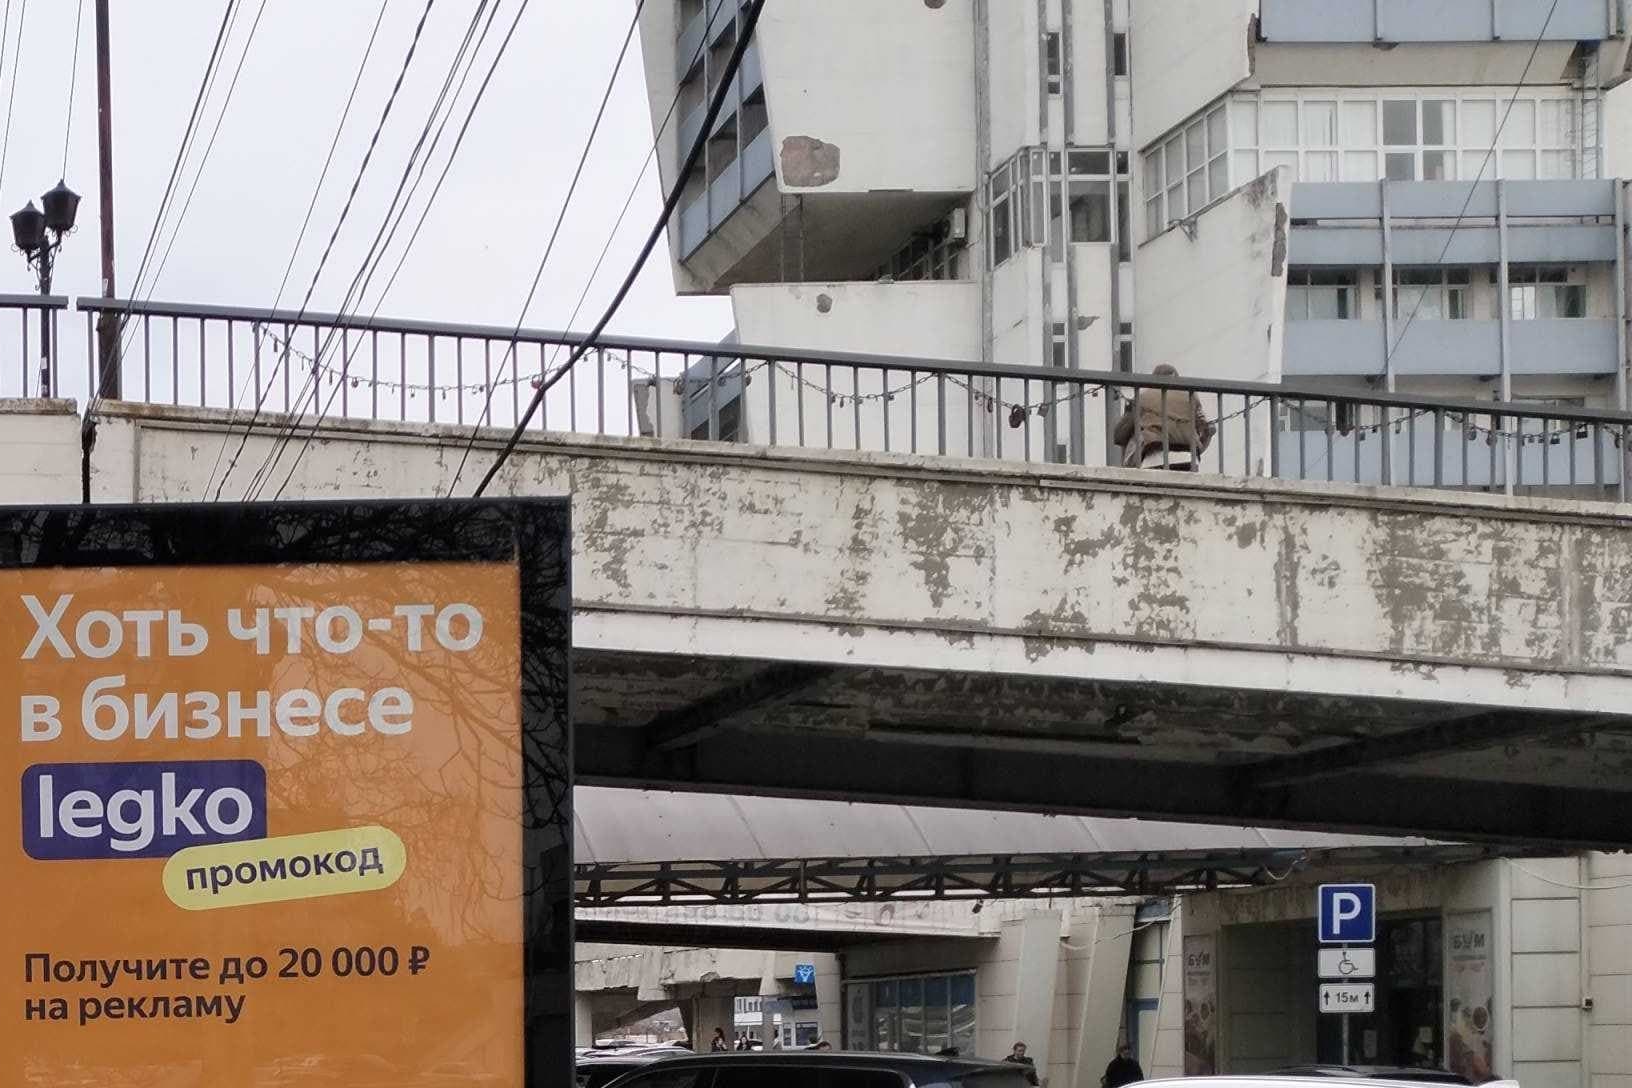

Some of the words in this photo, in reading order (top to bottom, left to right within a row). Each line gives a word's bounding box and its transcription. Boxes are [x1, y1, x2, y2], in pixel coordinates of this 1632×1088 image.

[20, 594, 209, 660] Хоть
[227, 600, 484, 656] что-то
[20, 694, 63, 742] в
[80, 675, 414, 741] бизнесе
[38, 772, 254, 852] legko
[185, 843, 385, 894] промокод
[1332, 892, 1362, 935] P
[24, 951, 212, 990] Получите
[218, 954, 269, 985] до
[279, 948, 324, 979] 20
[330, 946, 400, 978] 000
[24, 995, 69, 1022] на
[79, 991, 247, 1027] рекламу
